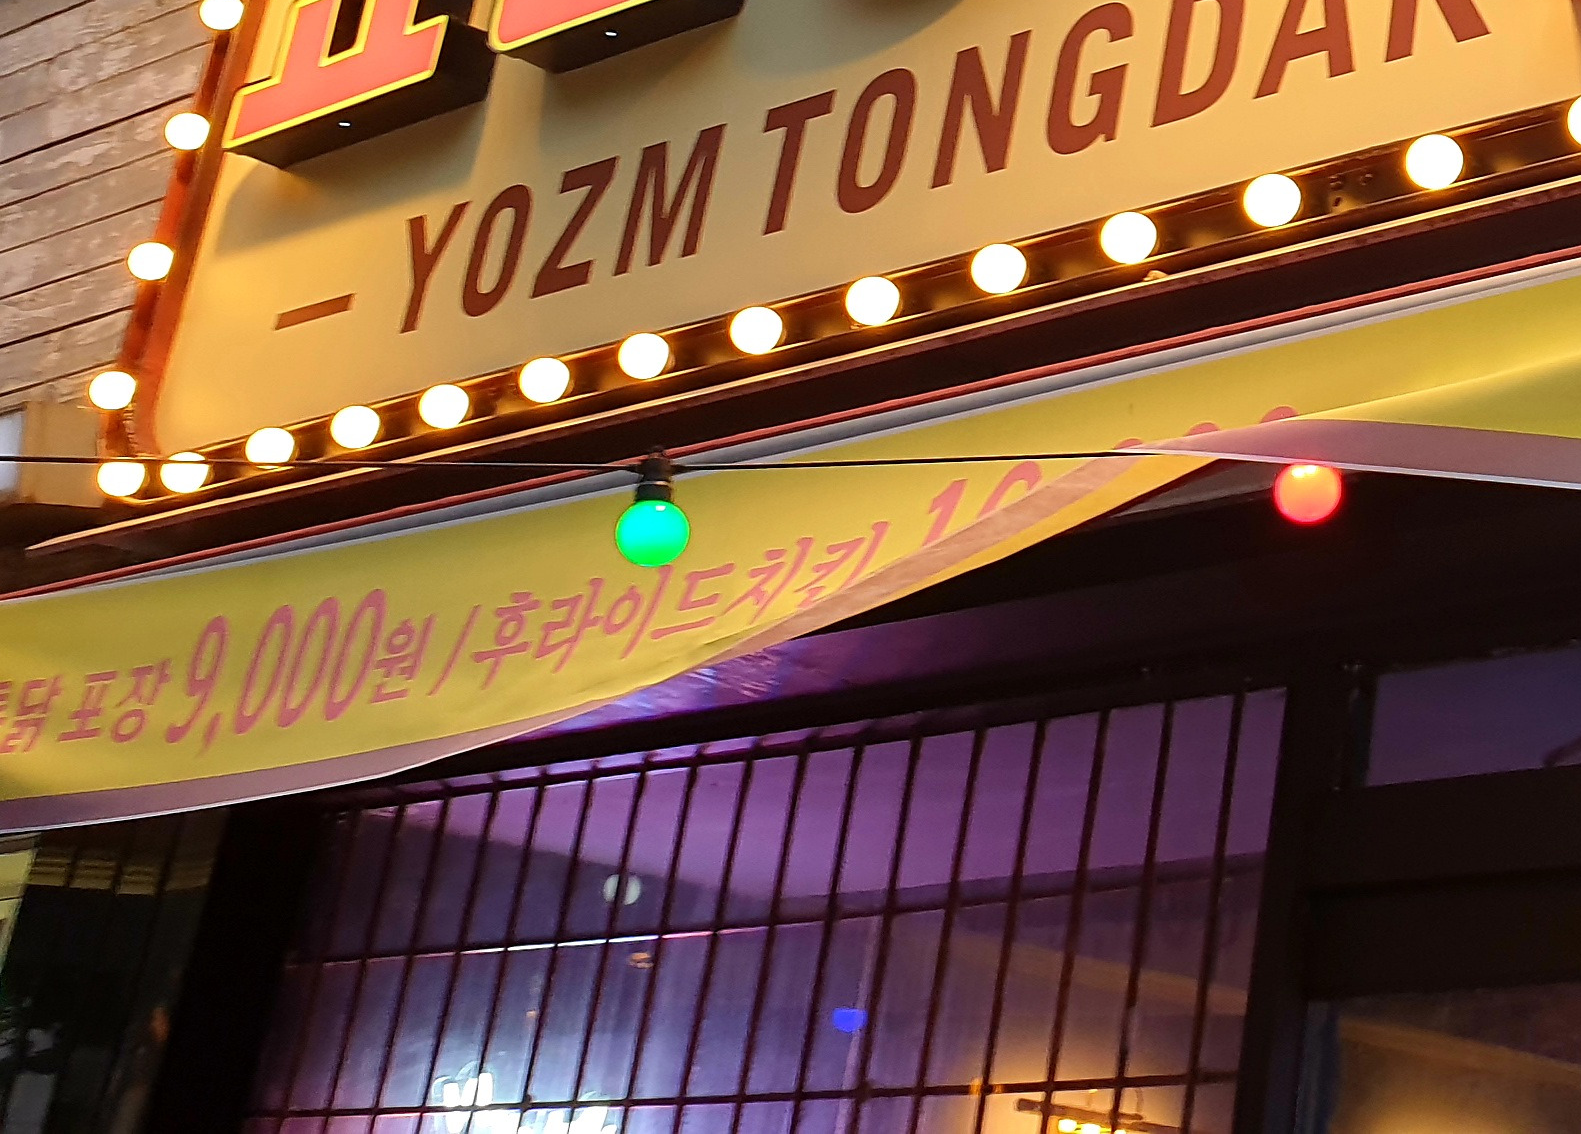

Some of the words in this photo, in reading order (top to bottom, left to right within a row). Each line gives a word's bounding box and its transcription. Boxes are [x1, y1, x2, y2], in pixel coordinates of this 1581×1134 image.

[399, 123, 727, 334] YOZM
[58, 657, 172, 743] 포장
[165, 587, 438, 758] 9,000원
